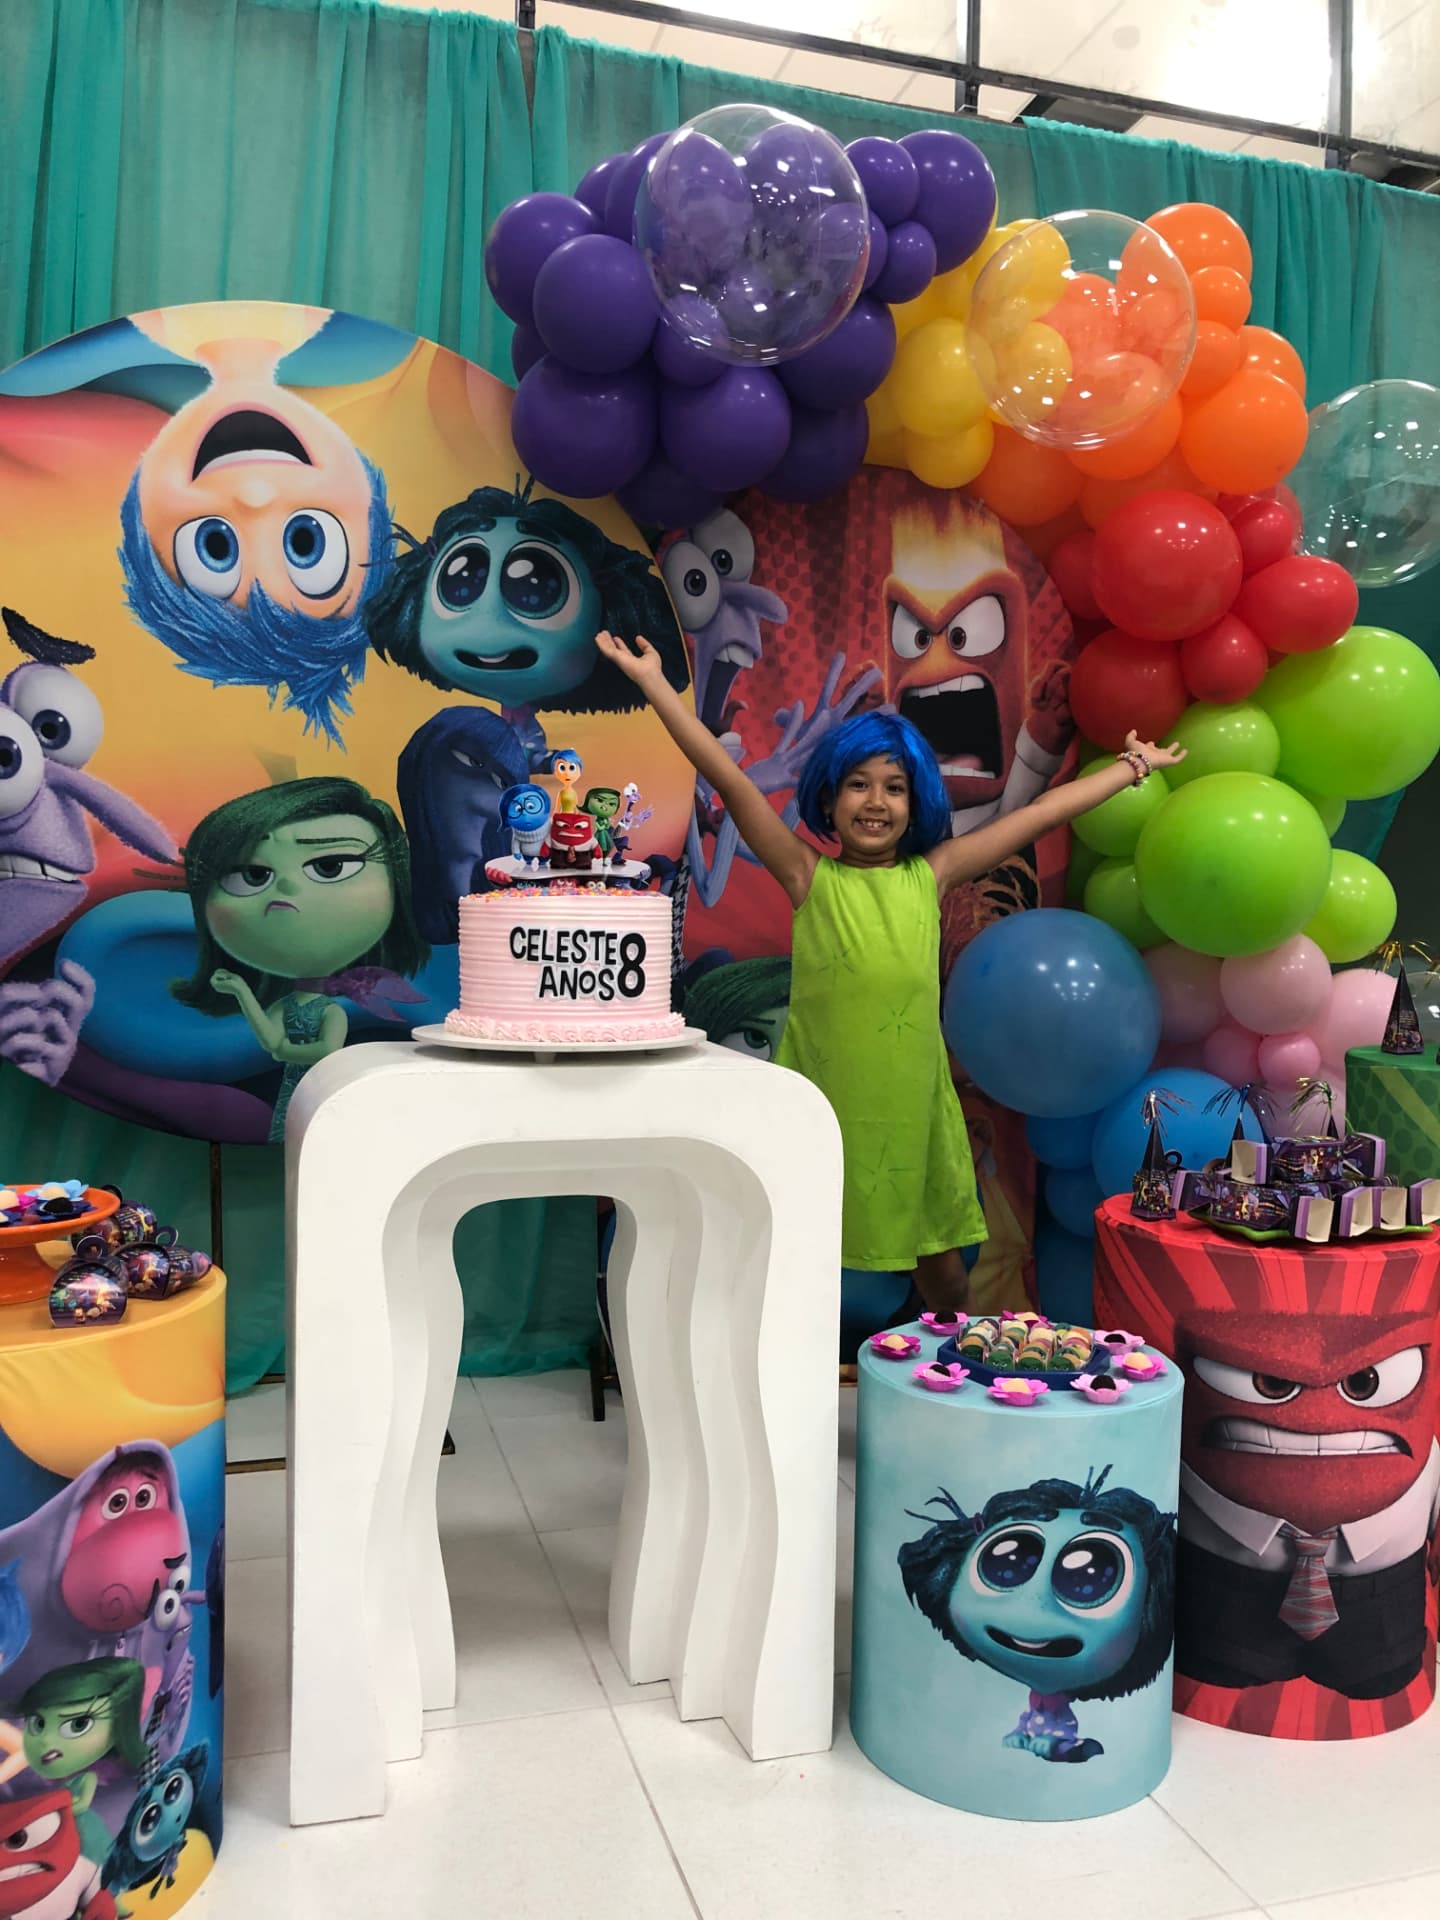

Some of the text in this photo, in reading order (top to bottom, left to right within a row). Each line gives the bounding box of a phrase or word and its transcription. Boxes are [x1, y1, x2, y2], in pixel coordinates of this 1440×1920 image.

[509, 926, 618, 966] CELESTE
[617, 932, 647, 998] 8
[538, 965, 615, 1001] ANOS
